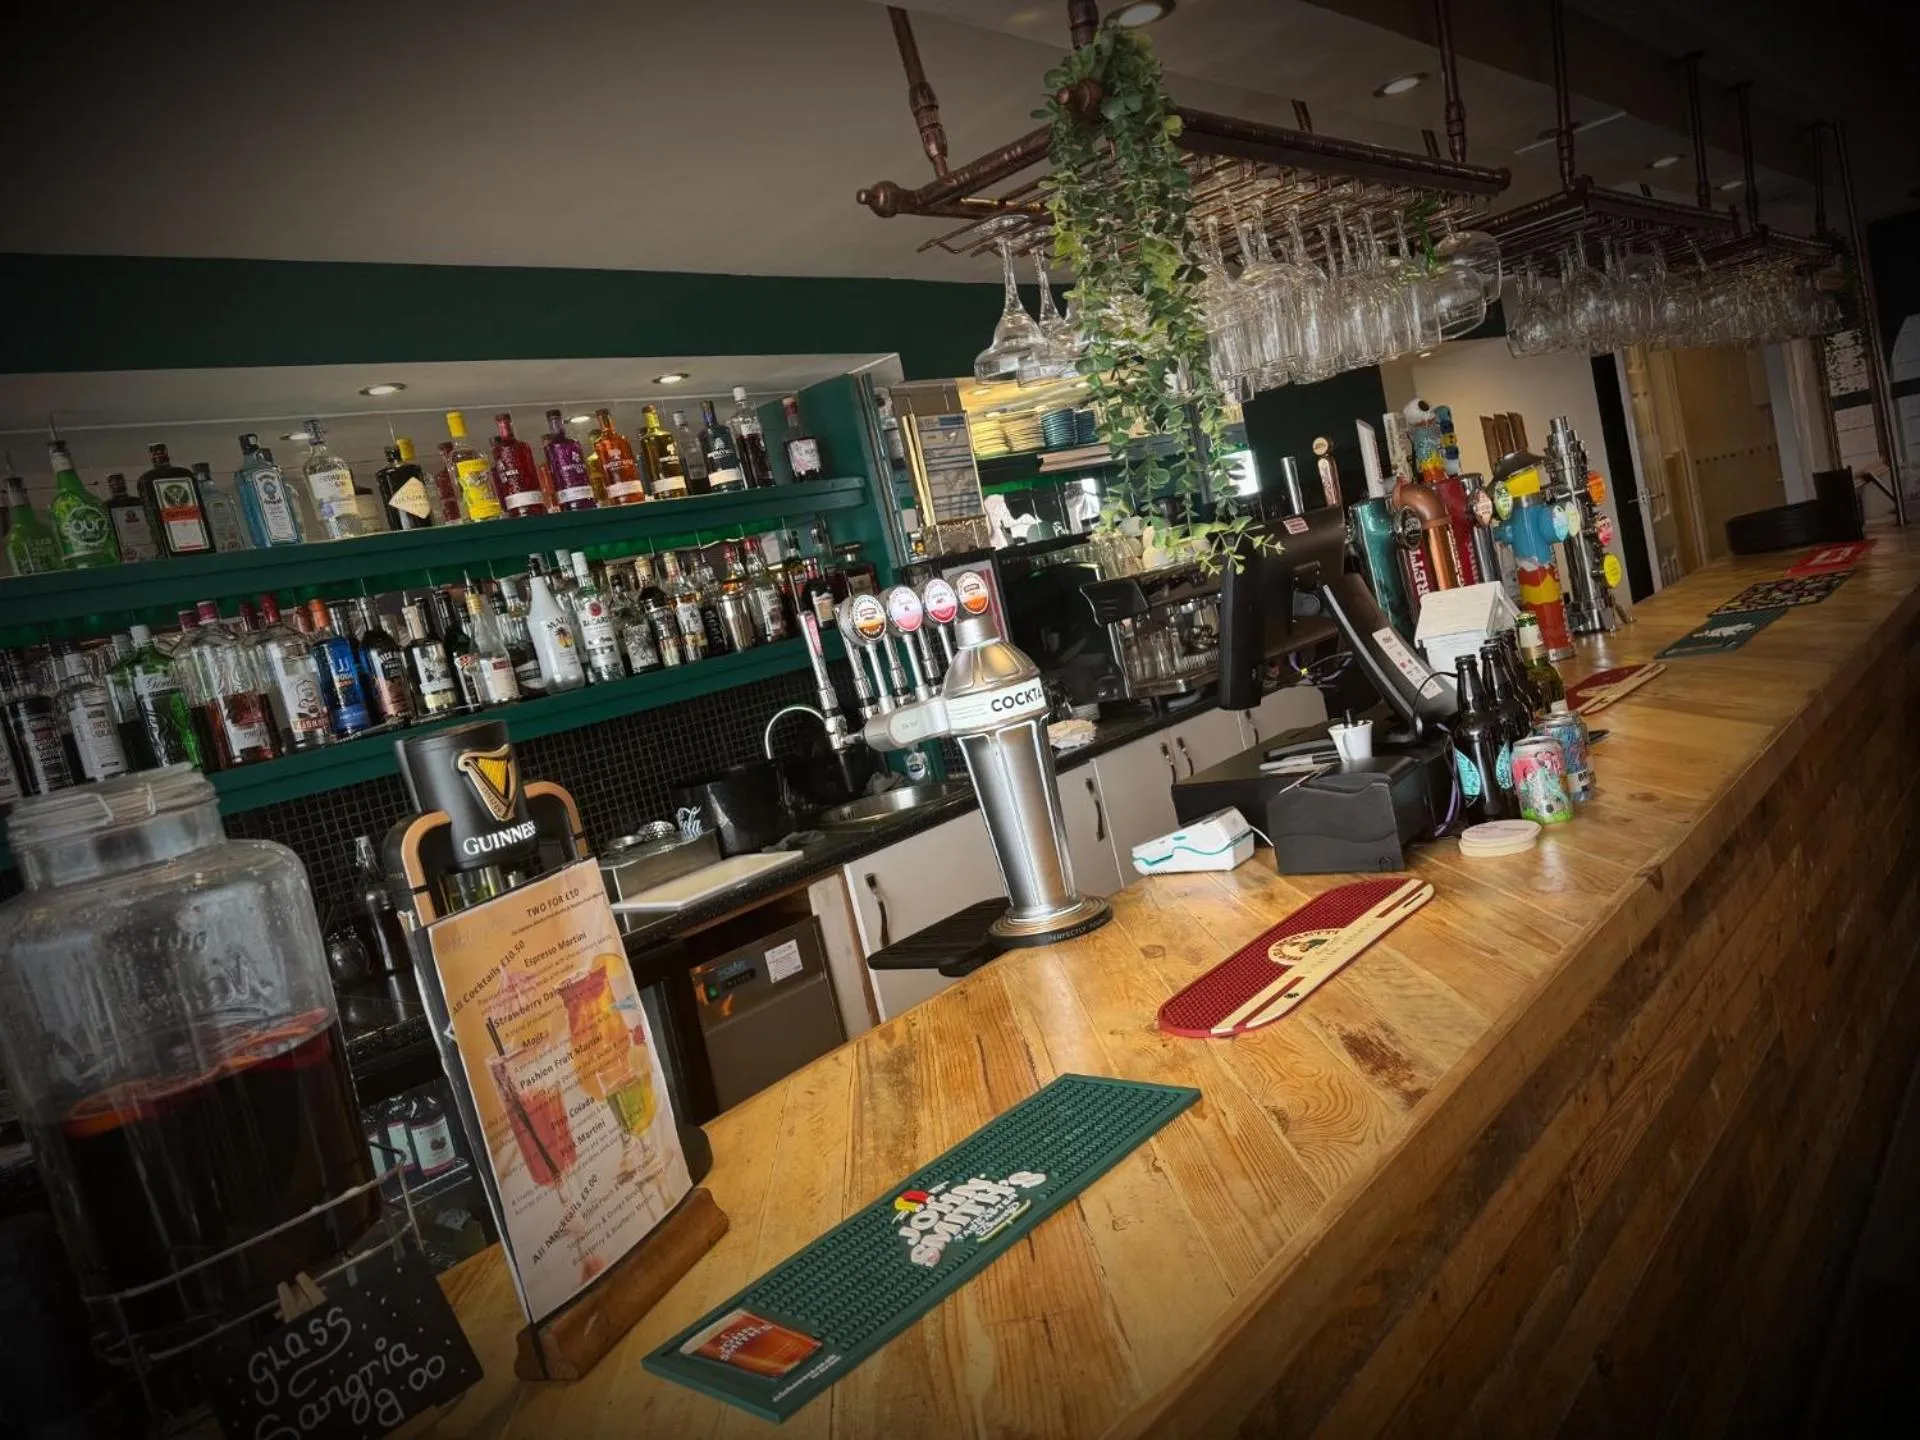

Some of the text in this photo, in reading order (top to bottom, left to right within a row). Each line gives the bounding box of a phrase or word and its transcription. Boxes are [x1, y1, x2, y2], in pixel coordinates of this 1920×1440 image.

[526, 888, 580, 917] TWO FOR £10
[524, 931, 588, 968] Espresso Martini
[453, 1001, 463, 1015] All
[463, 965, 502, 1004] Cocktails
[494, 997, 543, 1027] Strawberry
[542, 979, 574, 1003] Daiiri
[554, 1051, 574, 1070] Fruit
[573, 1034, 603, 1058] Martini
[569, 1096, 595, 1117] Colada
[577, 1120, 606, 1145] Martini
[531, 1245, 547, 1265] All
[546, 1201, 583, 1249] Mocktails
[899, 1178, 993, 1246] JOHN
[910, 1171, 1047, 1268] SMITH'S
[255, 1336, 419, 1440] Sangria
[375, 1354, 446, 1427] 8.00
